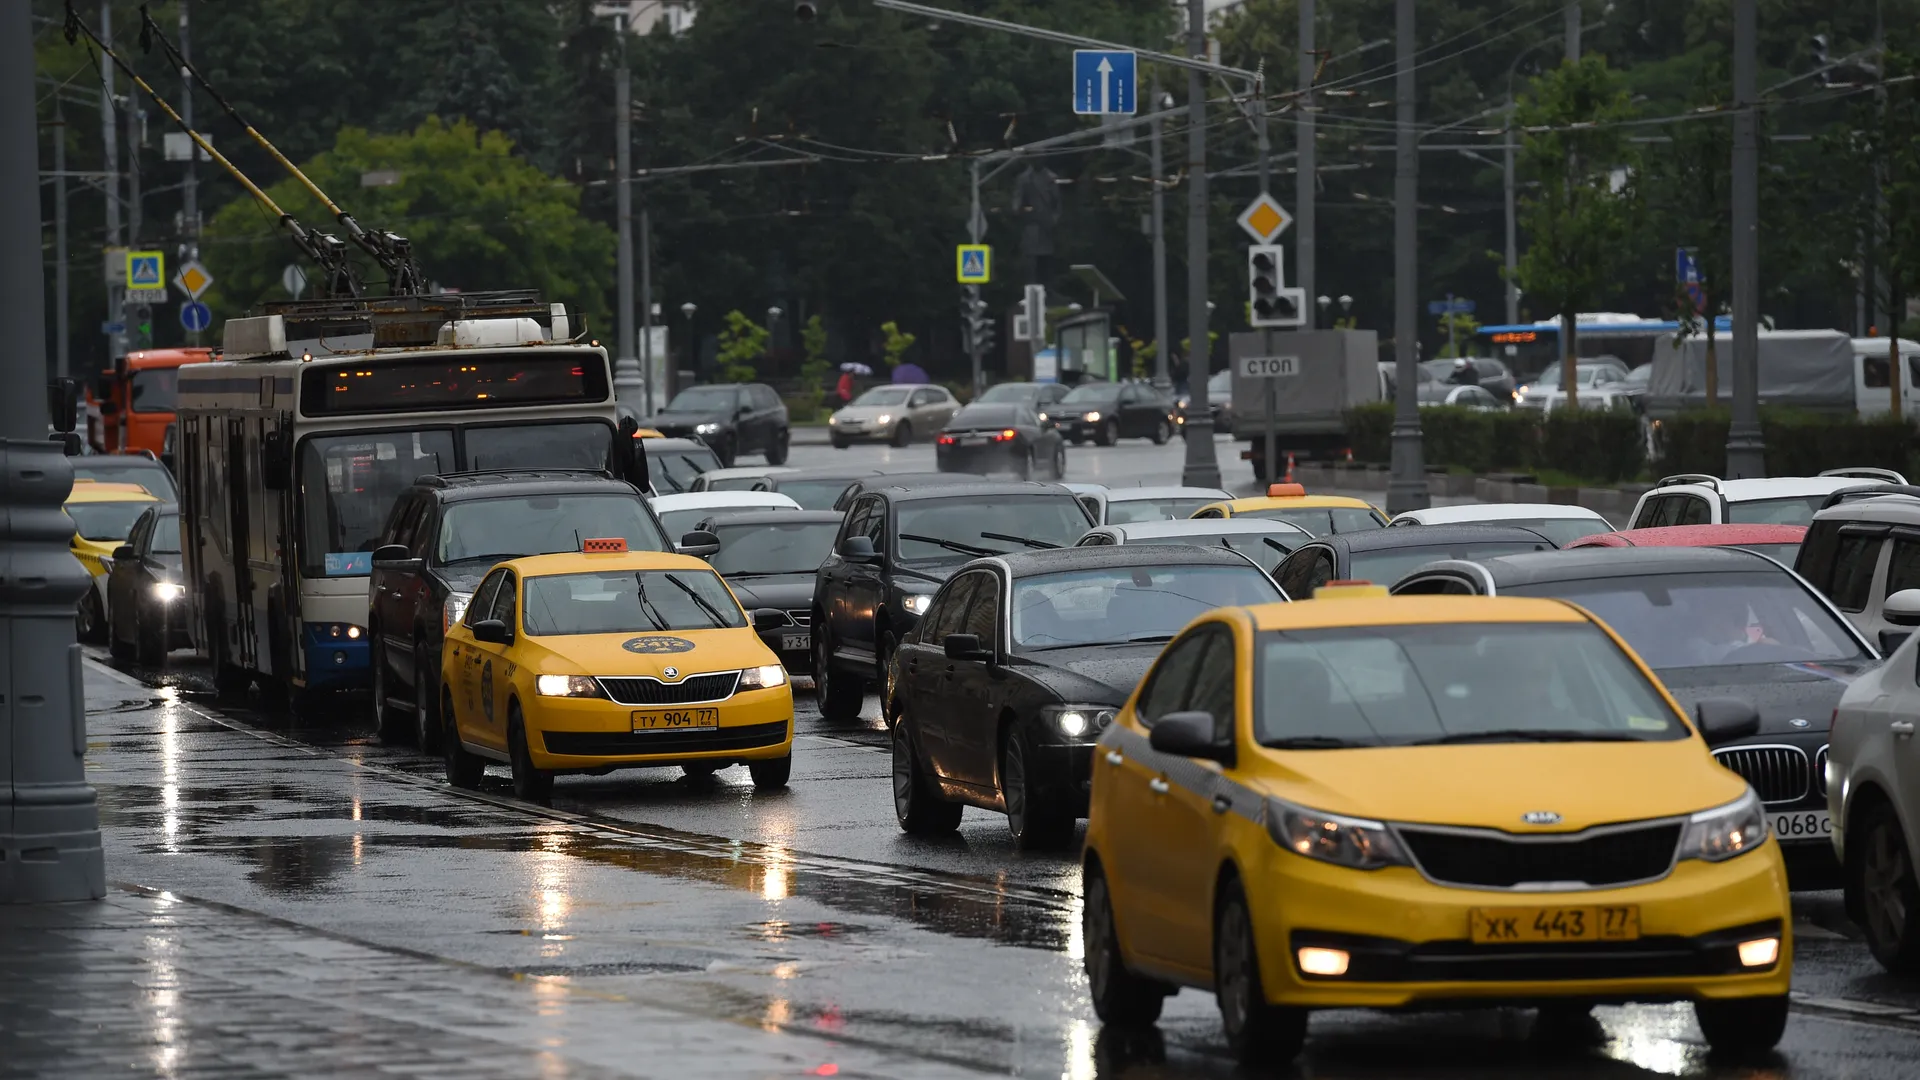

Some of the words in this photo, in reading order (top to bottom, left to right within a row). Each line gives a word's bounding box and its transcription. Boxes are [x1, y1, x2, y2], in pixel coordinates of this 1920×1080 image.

[1247, 358, 1292, 374] СТОП
[640, 716, 657, 727] ТУ
[664, 712, 691, 726] 904
[699, 710, 713, 721] 77
[1485, 916, 1520, 939] ХК
[1533, 909, 1586, 938] 443
[1603, 908, 1630, 928] 77
